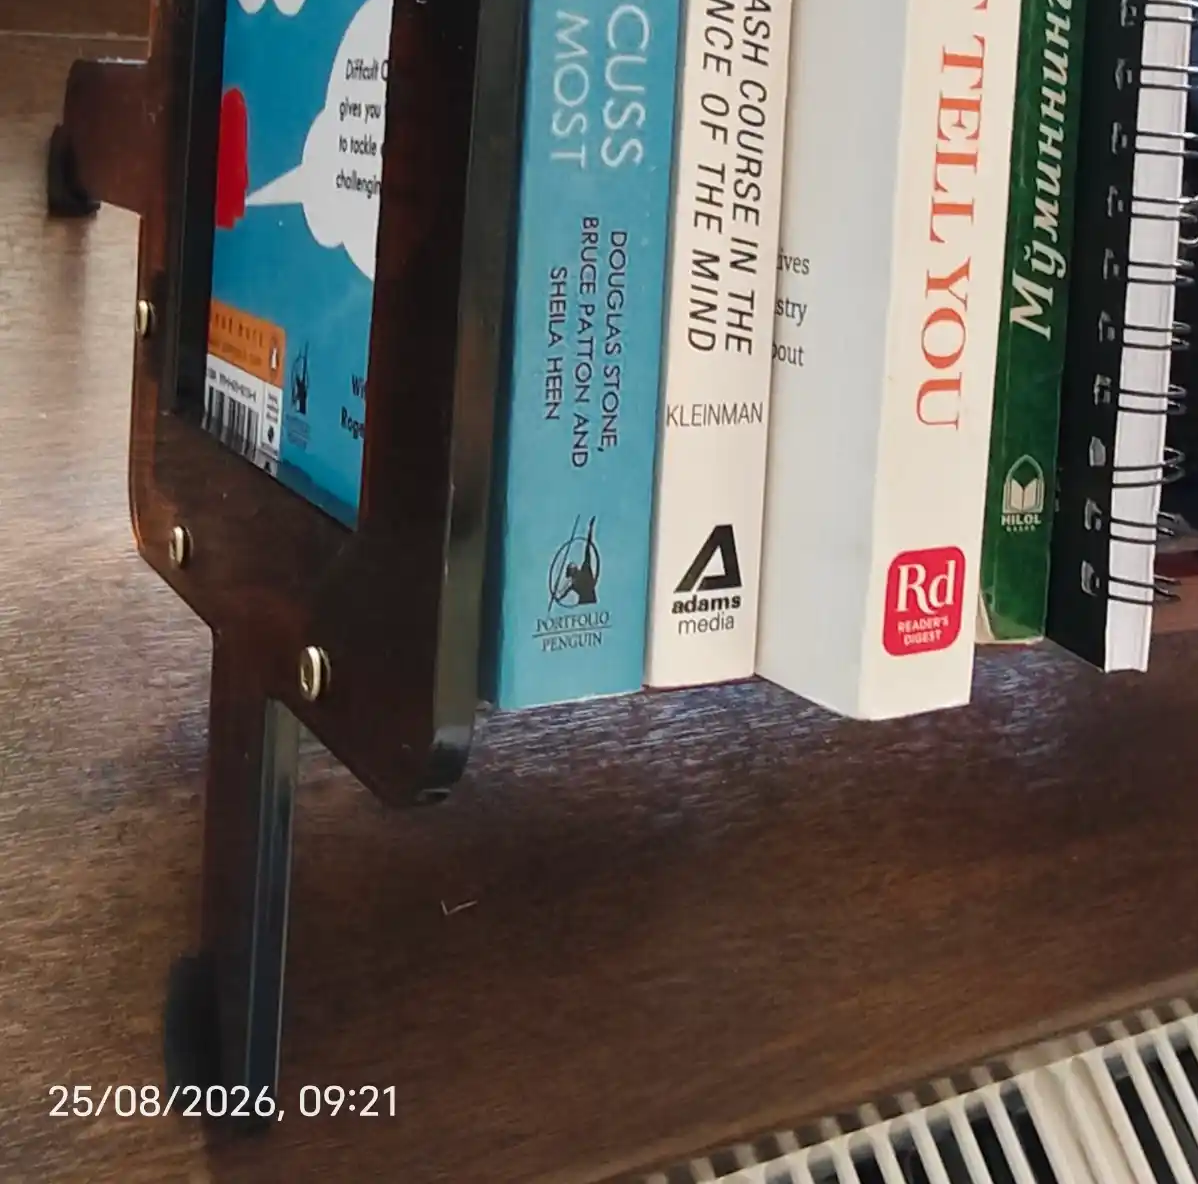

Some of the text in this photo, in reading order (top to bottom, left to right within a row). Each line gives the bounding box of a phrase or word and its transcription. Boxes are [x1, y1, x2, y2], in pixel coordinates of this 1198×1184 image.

[345, 59, 379, 82] Difficult
[549, 10, 590, 170] MOST
[339, 99, 381, 124] gives you
[699, 92, 730, 146] OF
[338, 134, 377, 157] to tackle
[732, 79, 768, 227] COURSE
[928, 33, 987, 244] TELL
[693, 163, 725, 235] THE
[728, 236, 759, 275] IN
[687, 248, 721, 353] MIND
[725, 289, 755, 356] THE
[544, 264, 568, 422] SHEILA HEEN
[571, 216, 600, 469] BRUCE PATTON AND
[597, 231, 628, 454] DOUGLAS STONE,
[914, 253, 973, 432] YOU
[665, 400, 764, 428] KLEINMAN
[1001, 514, 1043, 527] HILOL
[671, 594, 742, 615] adams
[896, 559, 957, 616] Rd
[536, 611, 610, 633] PORTFOLIO
[541, 631, 603, 652] PENGUIN
[677, 613, 736, 636] media
[897, 615, 949, 634] READER'S
[903, 628, 943, 646] DIGEST
